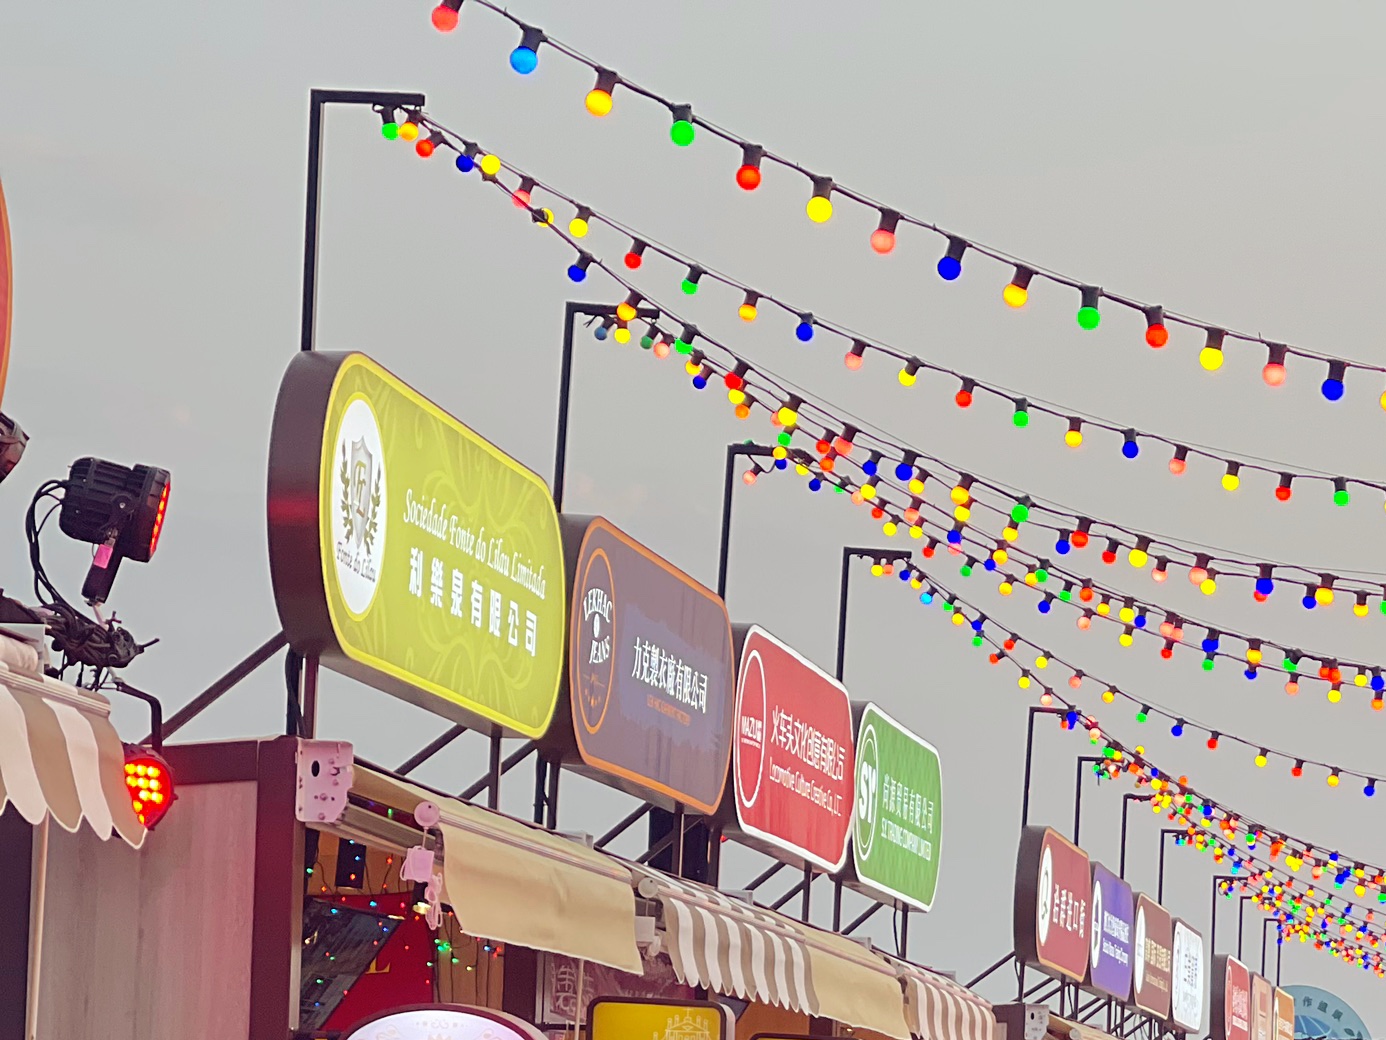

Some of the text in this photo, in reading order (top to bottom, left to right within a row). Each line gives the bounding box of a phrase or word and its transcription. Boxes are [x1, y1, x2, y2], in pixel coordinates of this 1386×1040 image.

[403, 488, 546, 600] Sociedade Fonte do Lilau Limitada
[408, 546, 537, 657] 利樂泉有限公司
[583, 588, 613, 623] LEKHAC
[588, 635, 610, 664] JEANS
[631, 636, 708, 714] 力克製衣廠有限公司
[859, 761, 877, 823] SY
